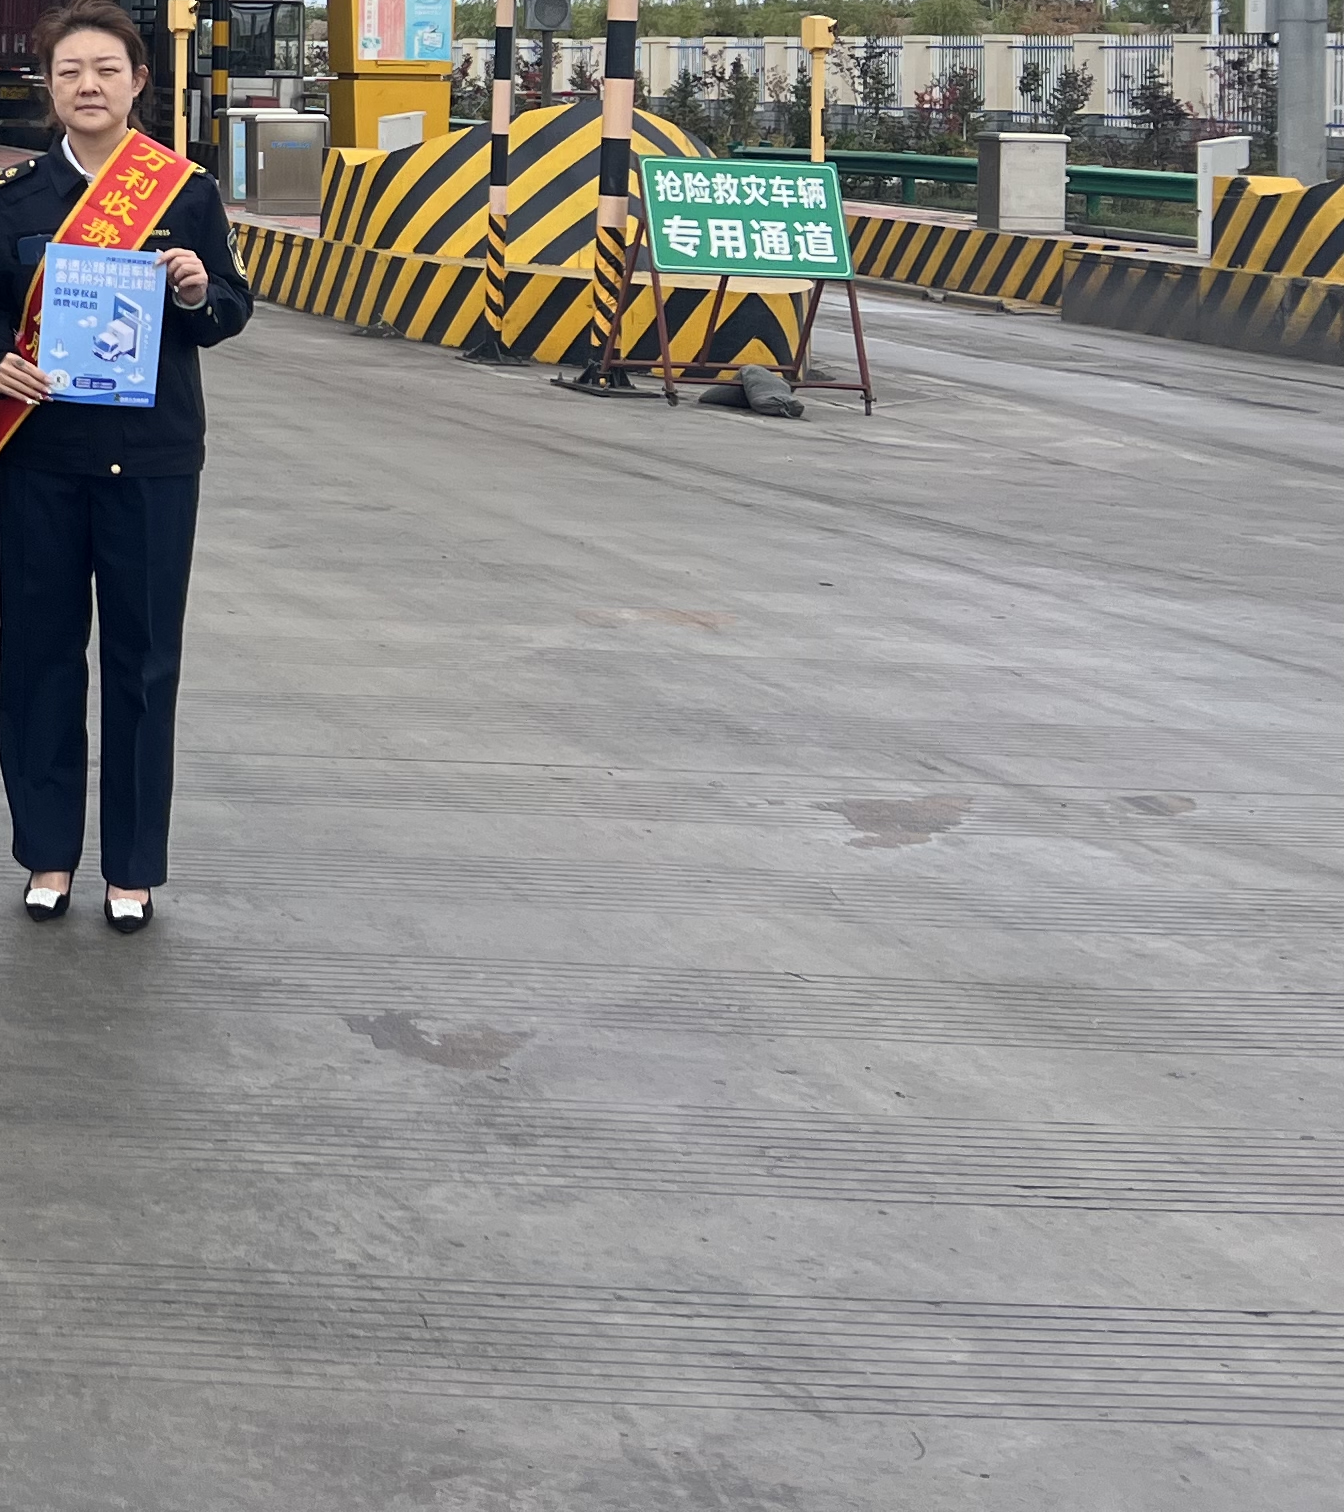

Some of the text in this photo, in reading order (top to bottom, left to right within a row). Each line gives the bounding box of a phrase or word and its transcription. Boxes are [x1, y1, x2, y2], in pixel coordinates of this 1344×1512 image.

[653, 169, 828, 210] 抢险救灾车辆
[661, 215, 839, 264] 专用通道
